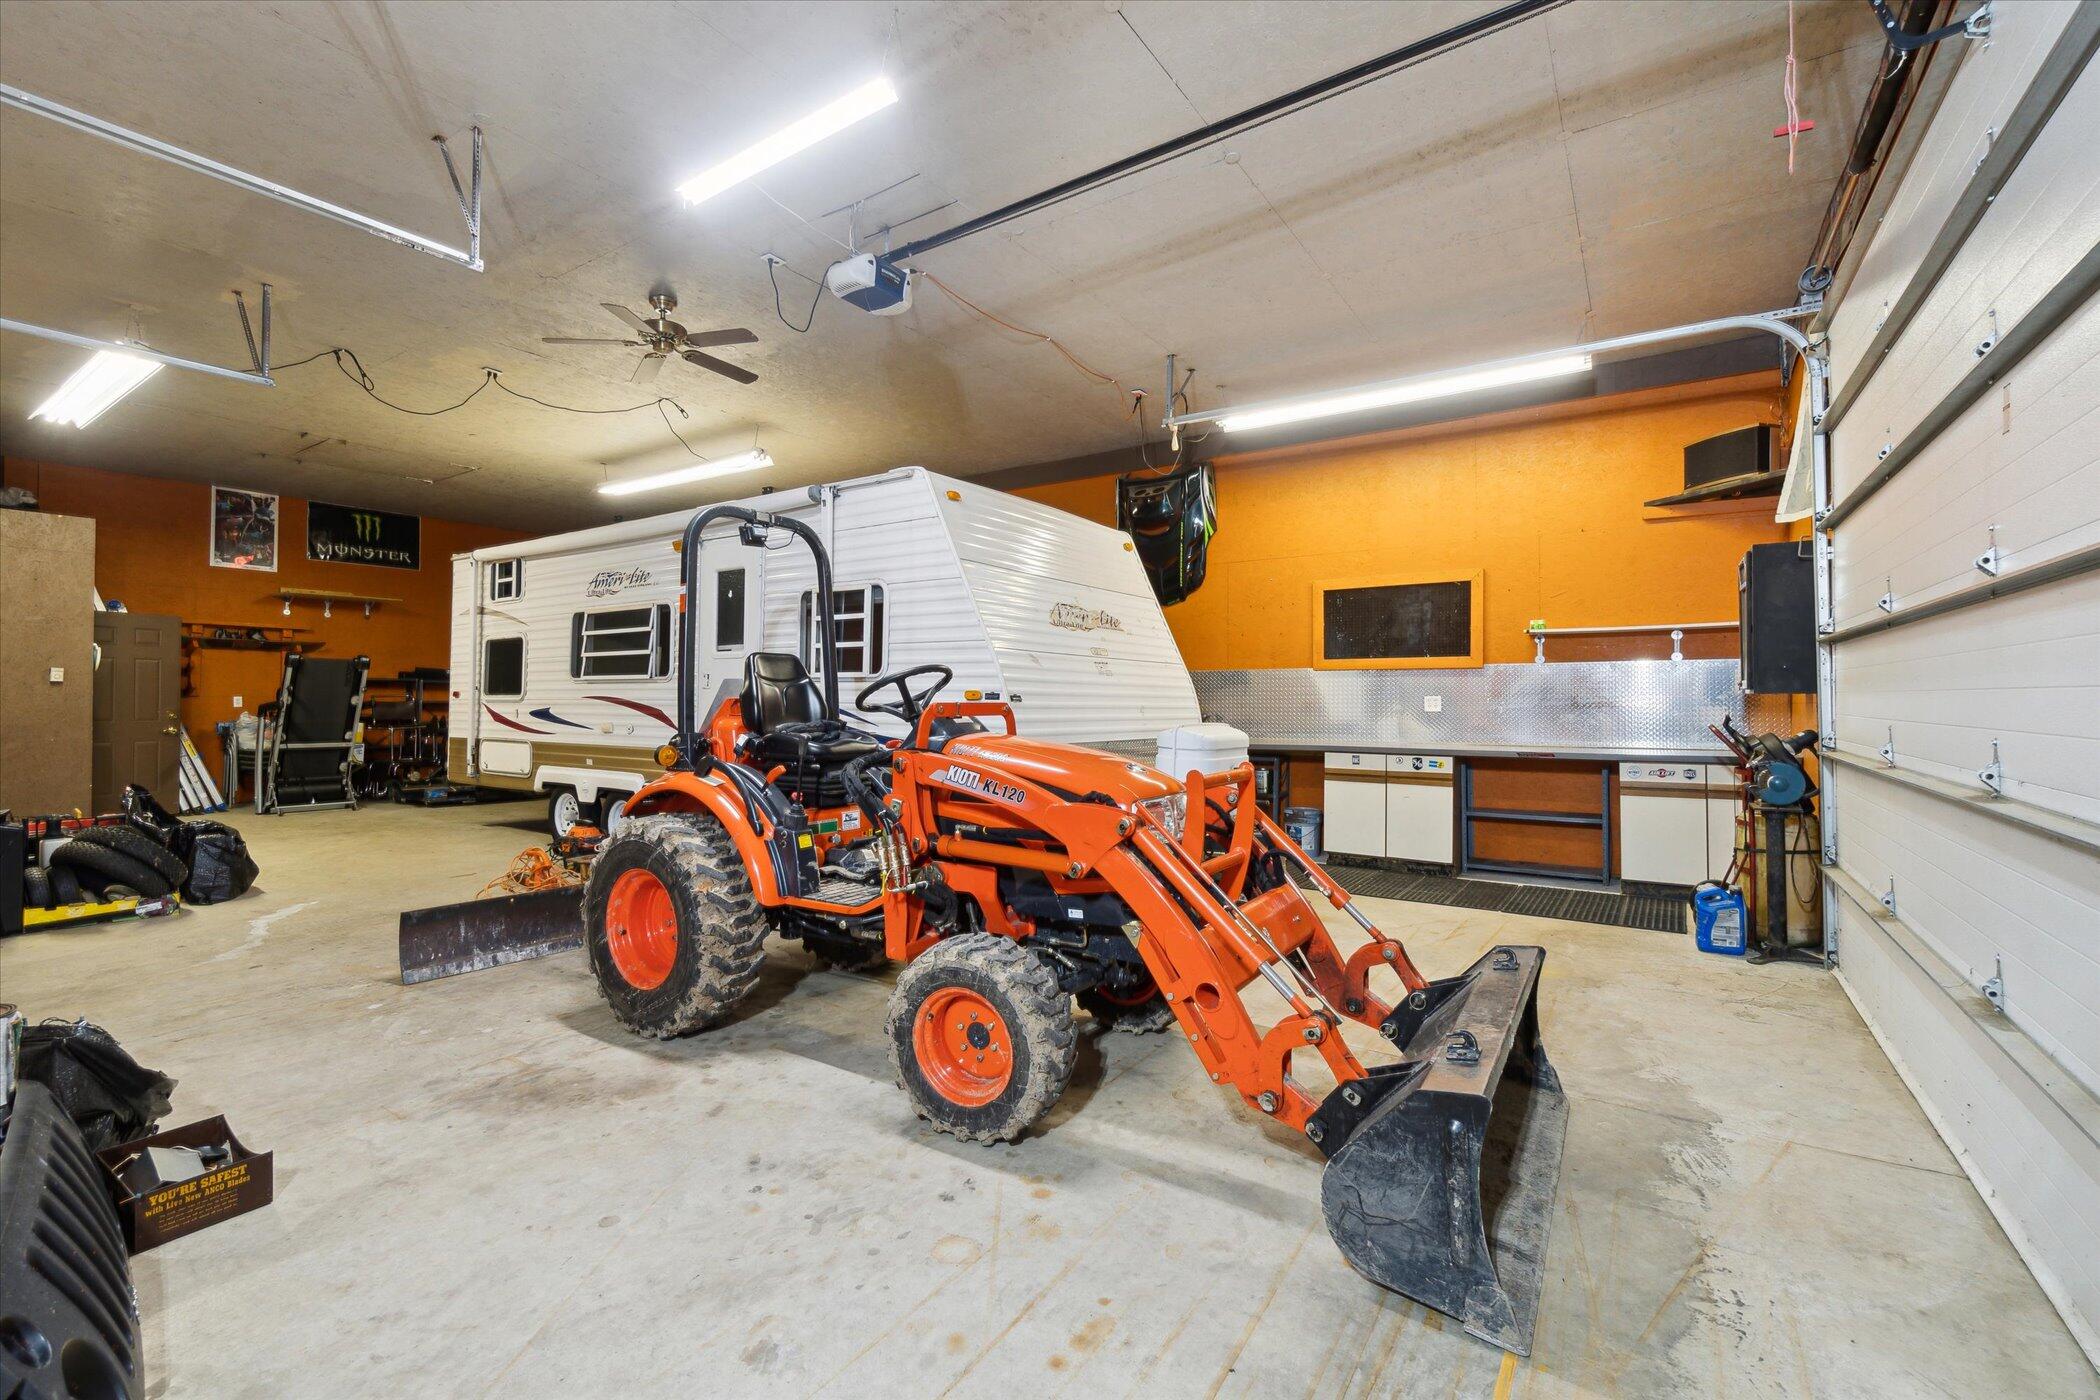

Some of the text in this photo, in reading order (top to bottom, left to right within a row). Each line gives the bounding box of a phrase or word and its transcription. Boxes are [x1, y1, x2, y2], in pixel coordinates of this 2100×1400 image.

[316, 542, 412, 564] MONSTER
[945, 764, 1025, 804] KIOTI KL120
[144, 1205, 165, 1218] with
[204, 1183, 225, 1197] ANCO
[226, 1174, 252, 1189] Blades
[148, 1163, 248, 1207] YOU'RE SAFEST
